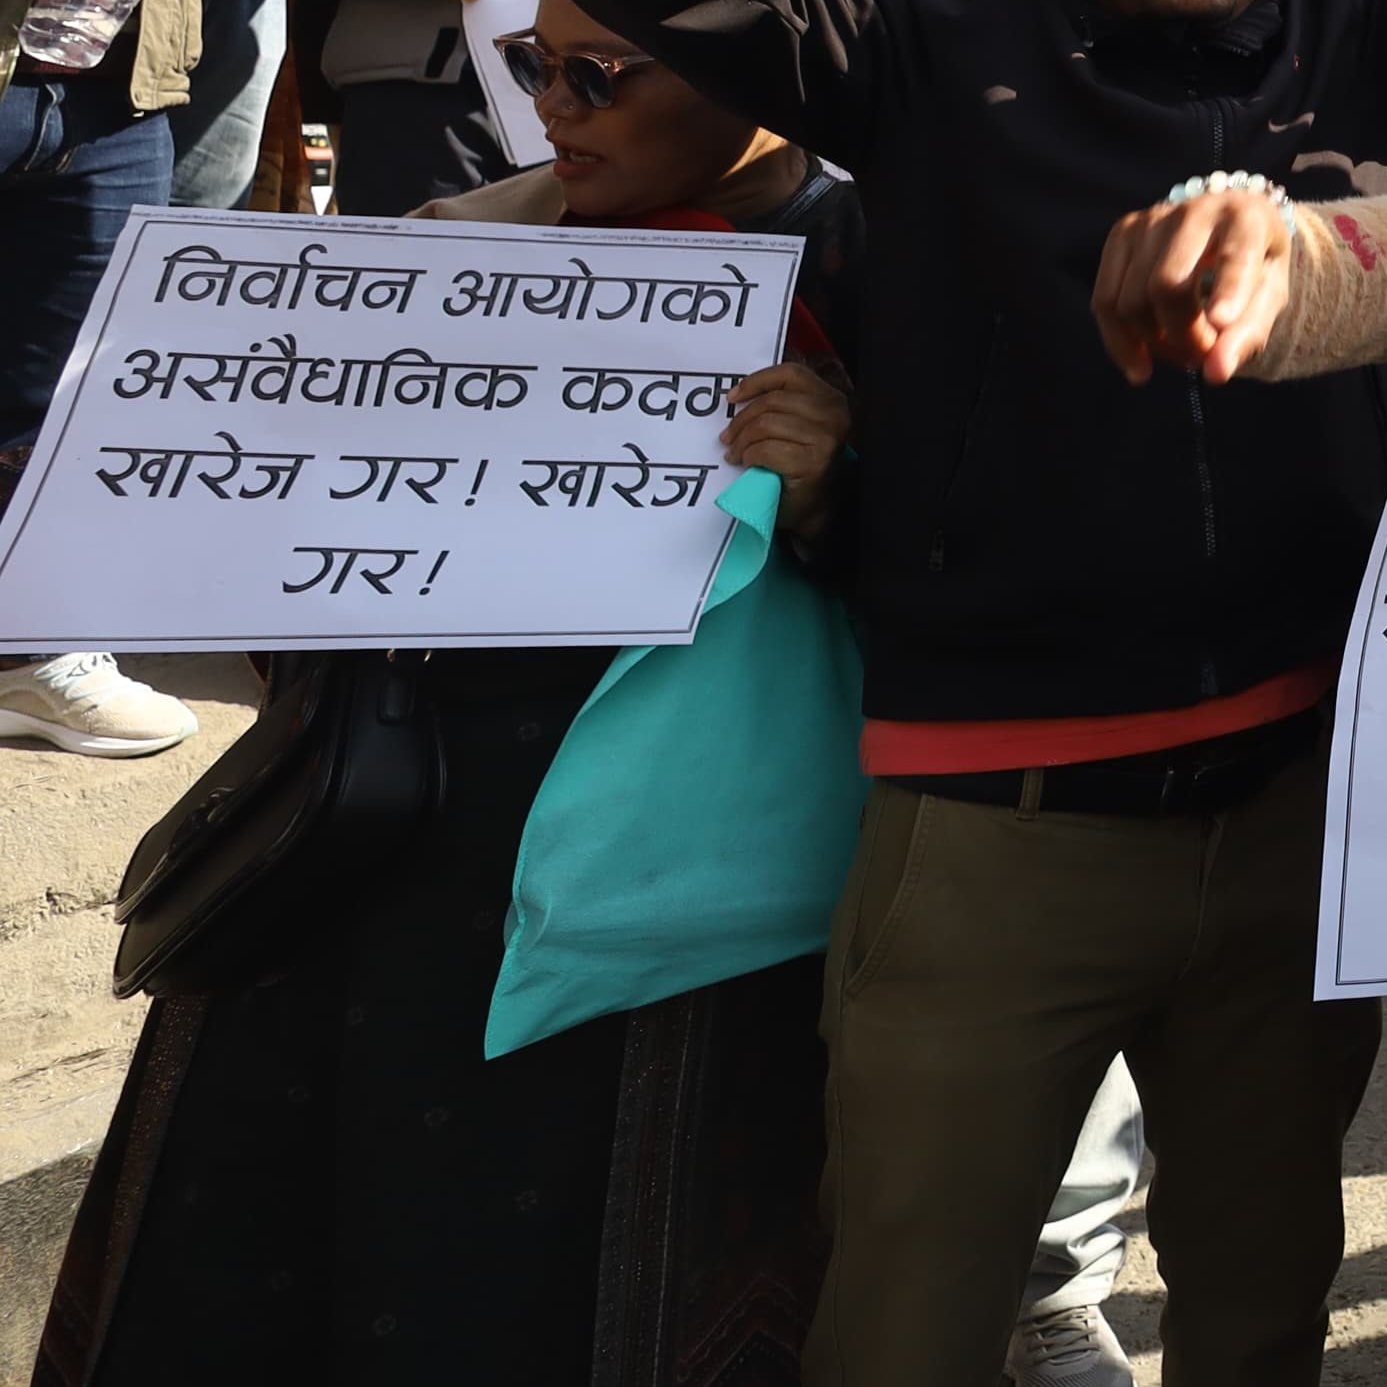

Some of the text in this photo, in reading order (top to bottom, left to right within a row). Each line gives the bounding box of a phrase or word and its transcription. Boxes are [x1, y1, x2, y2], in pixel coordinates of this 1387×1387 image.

[155, 244, 759, 327] निर्वाचन आयोगको
[113, 334, 742, 422] असंवैधानिक कदम
[96, 431, 315, 499] खारेज
[520, 443, 719, 507] खारेज
